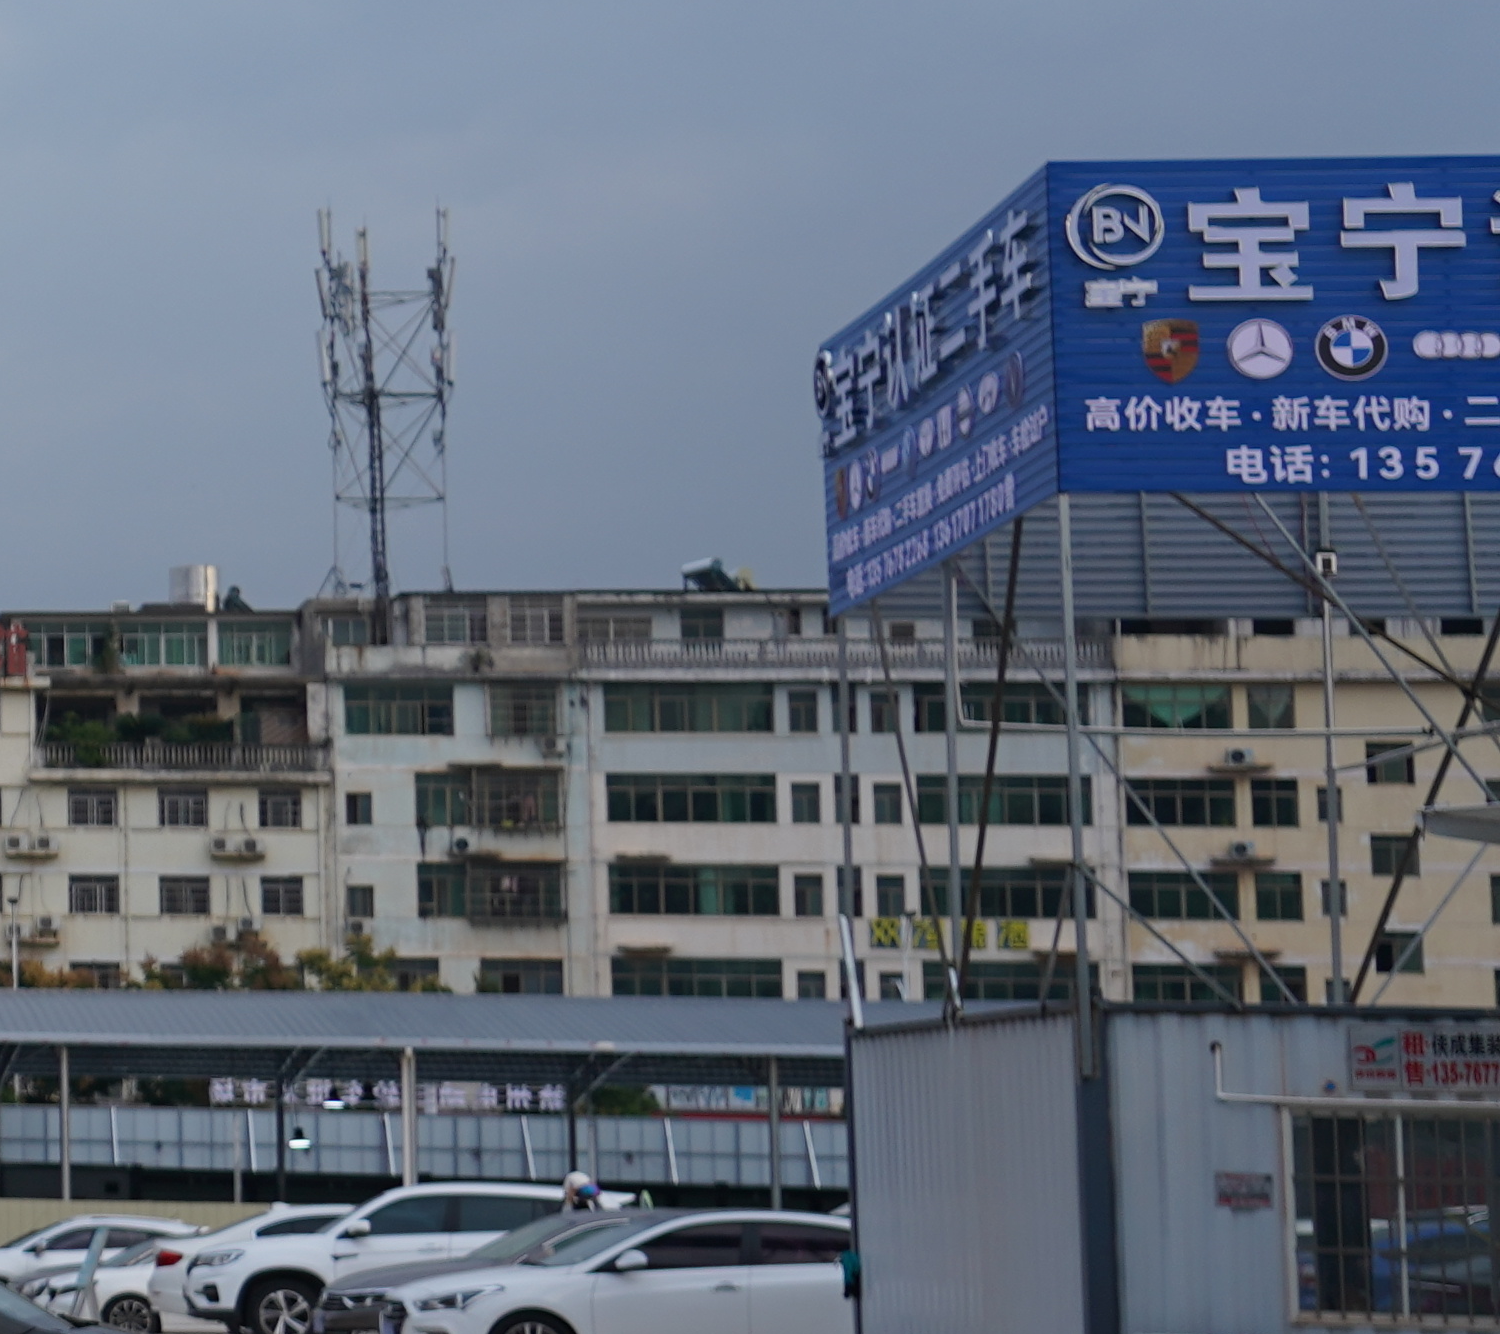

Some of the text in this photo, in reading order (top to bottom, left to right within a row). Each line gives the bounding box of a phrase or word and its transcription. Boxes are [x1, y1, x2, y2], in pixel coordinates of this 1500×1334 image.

[831, 208, 1032, 448] 宝宁认证二手车
[1187, 181, 1500, 301] 宝宁
